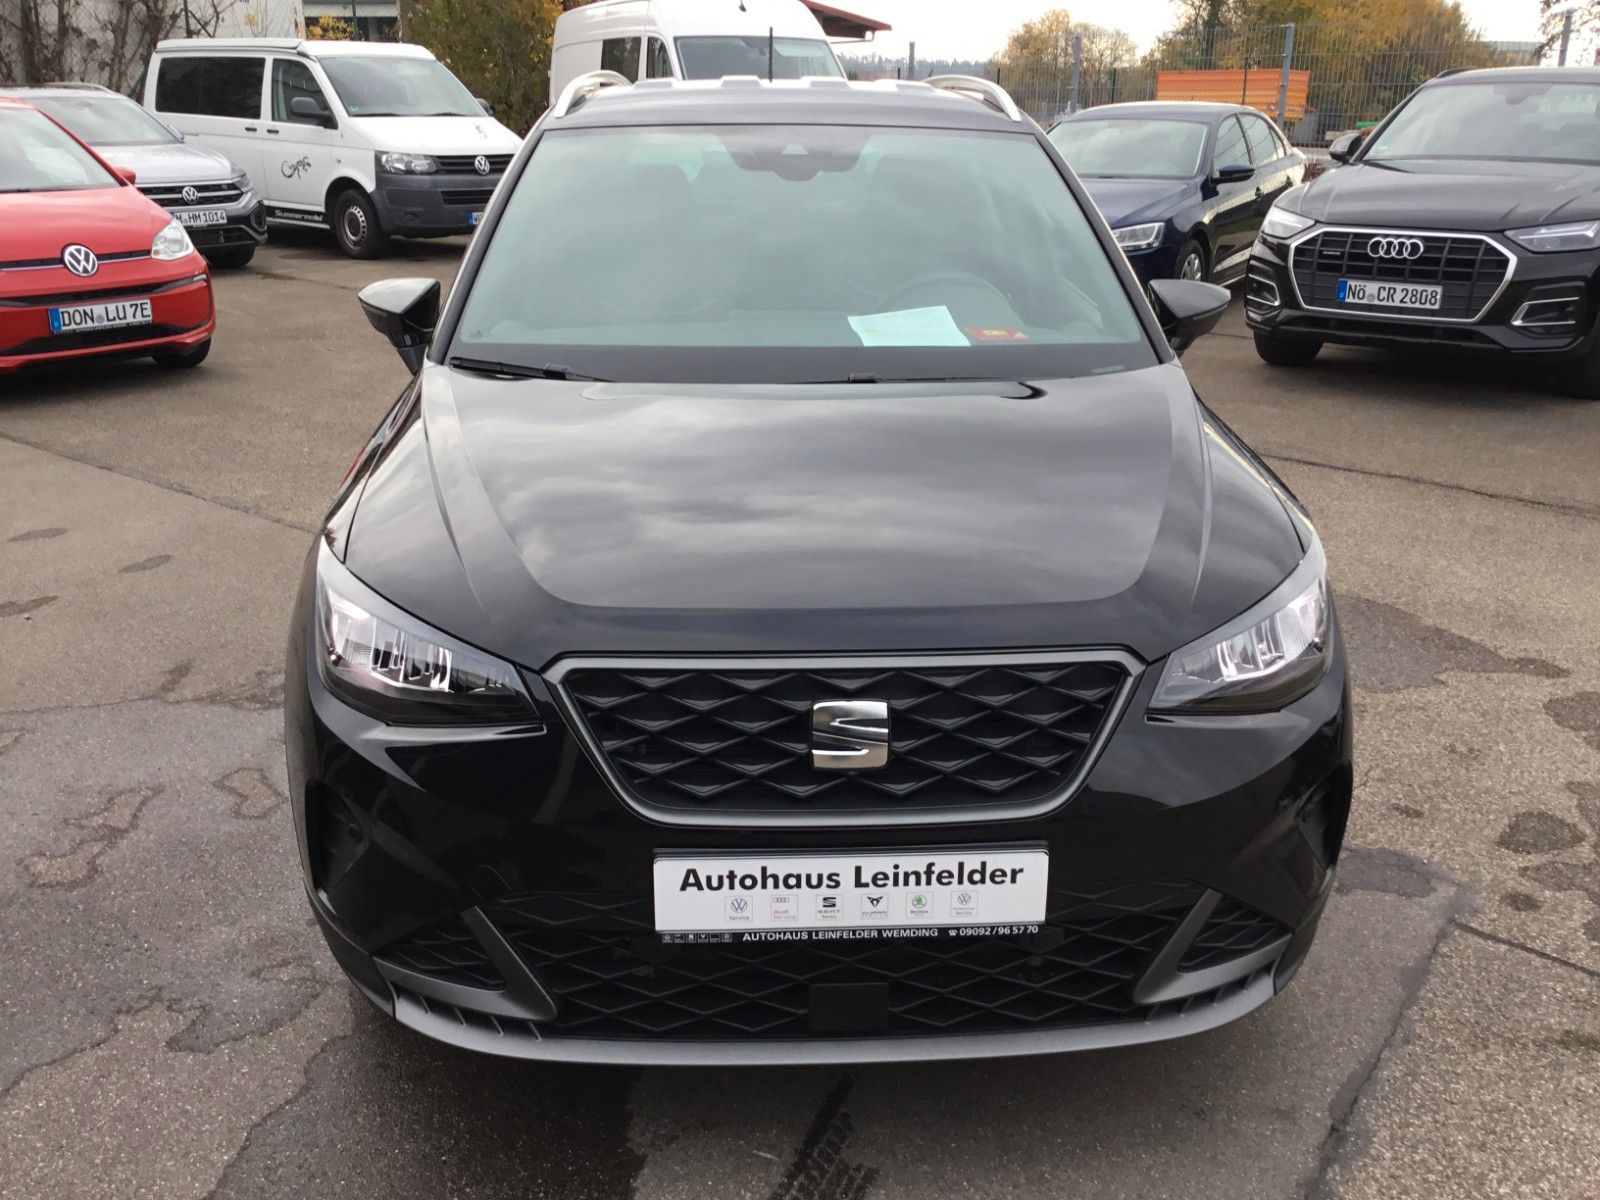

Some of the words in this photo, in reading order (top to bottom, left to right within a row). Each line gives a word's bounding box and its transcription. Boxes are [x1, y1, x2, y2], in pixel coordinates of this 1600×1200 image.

[188, 213, 202, 224] HM
[203, 211, 225, 223] 1014
[1347, 284, 1366, 301] Nö
[1377, 286, 1397, 303] CR
[1400, 288, 1439, 306] 2808
[60, 308, 95, 327] DON
[105, 305, 127, 322] LU
[130, 302, 151, 319] 7E
[680, 866, 841, 892] Autohaus
[854, 861, 1024, 888] Leinfelder
[742, 931, 809, 942] AUTOHAUS
[812, 930, 878, 940] LEINFELDER
[882, 929, 939, 938] WEMDING
